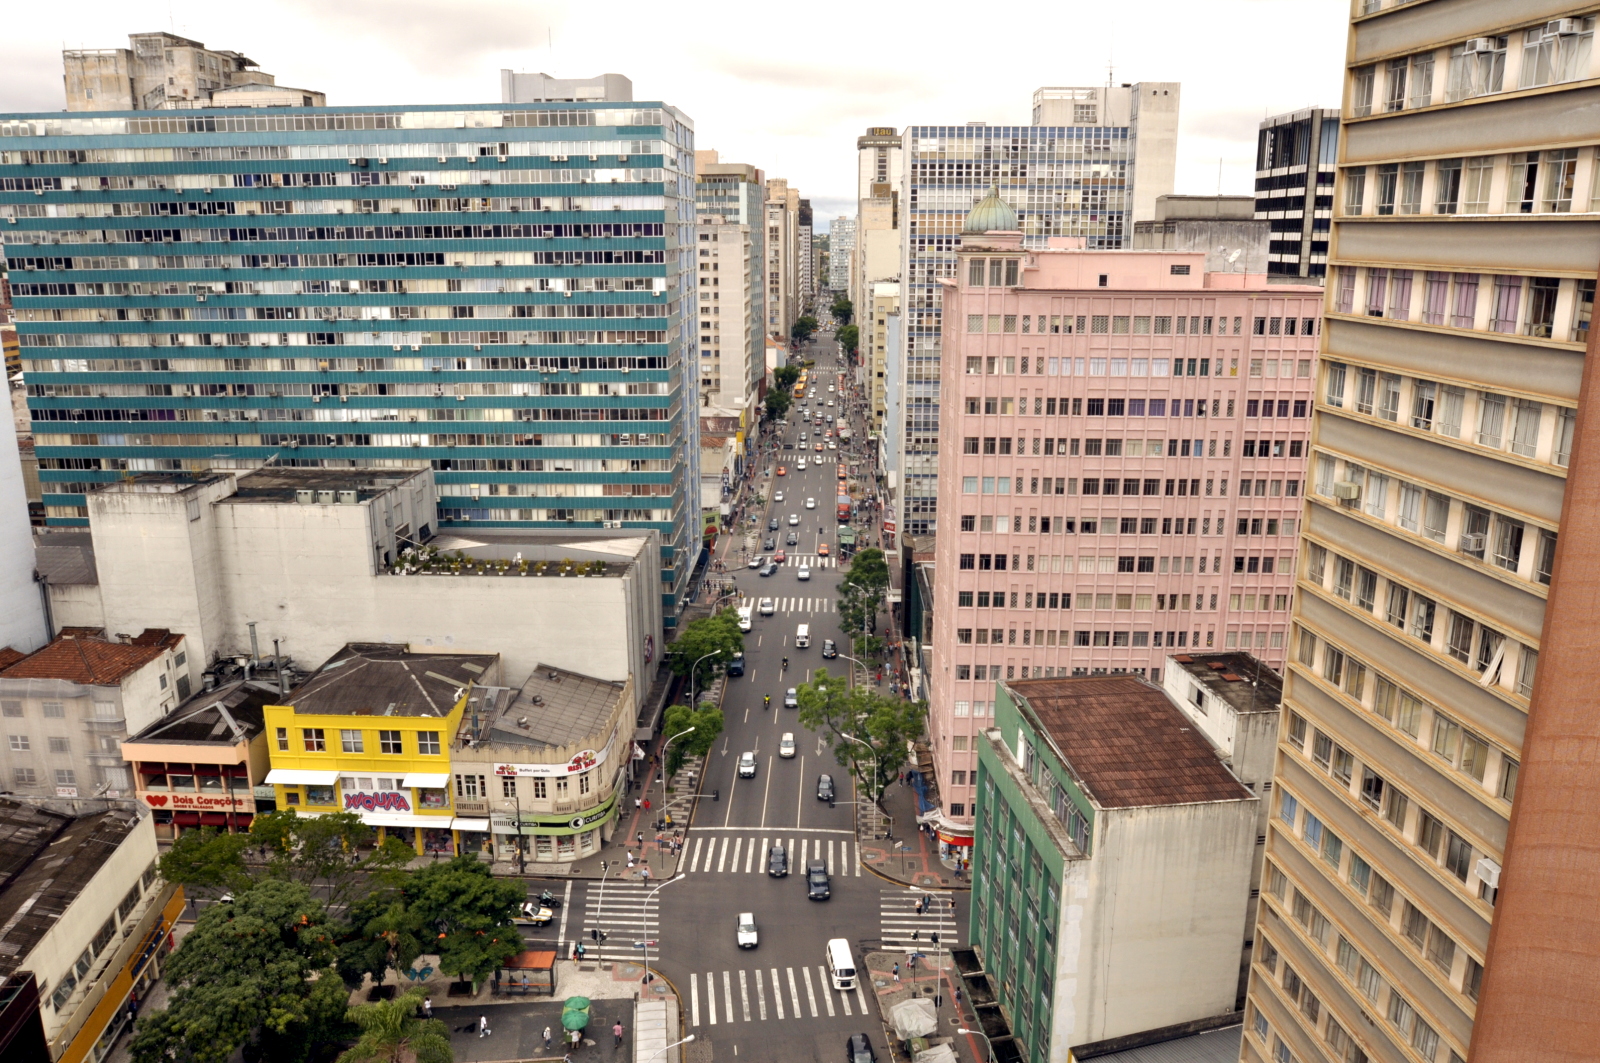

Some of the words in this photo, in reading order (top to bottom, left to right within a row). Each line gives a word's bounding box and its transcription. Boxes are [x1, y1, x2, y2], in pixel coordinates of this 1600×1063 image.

[172, 795, 194, 804] Dois
[196, 796, 243, 807] Corações
[344, 791, 410, 811] XIQUITA
[585, 811, 606, 823] CURITIBA
